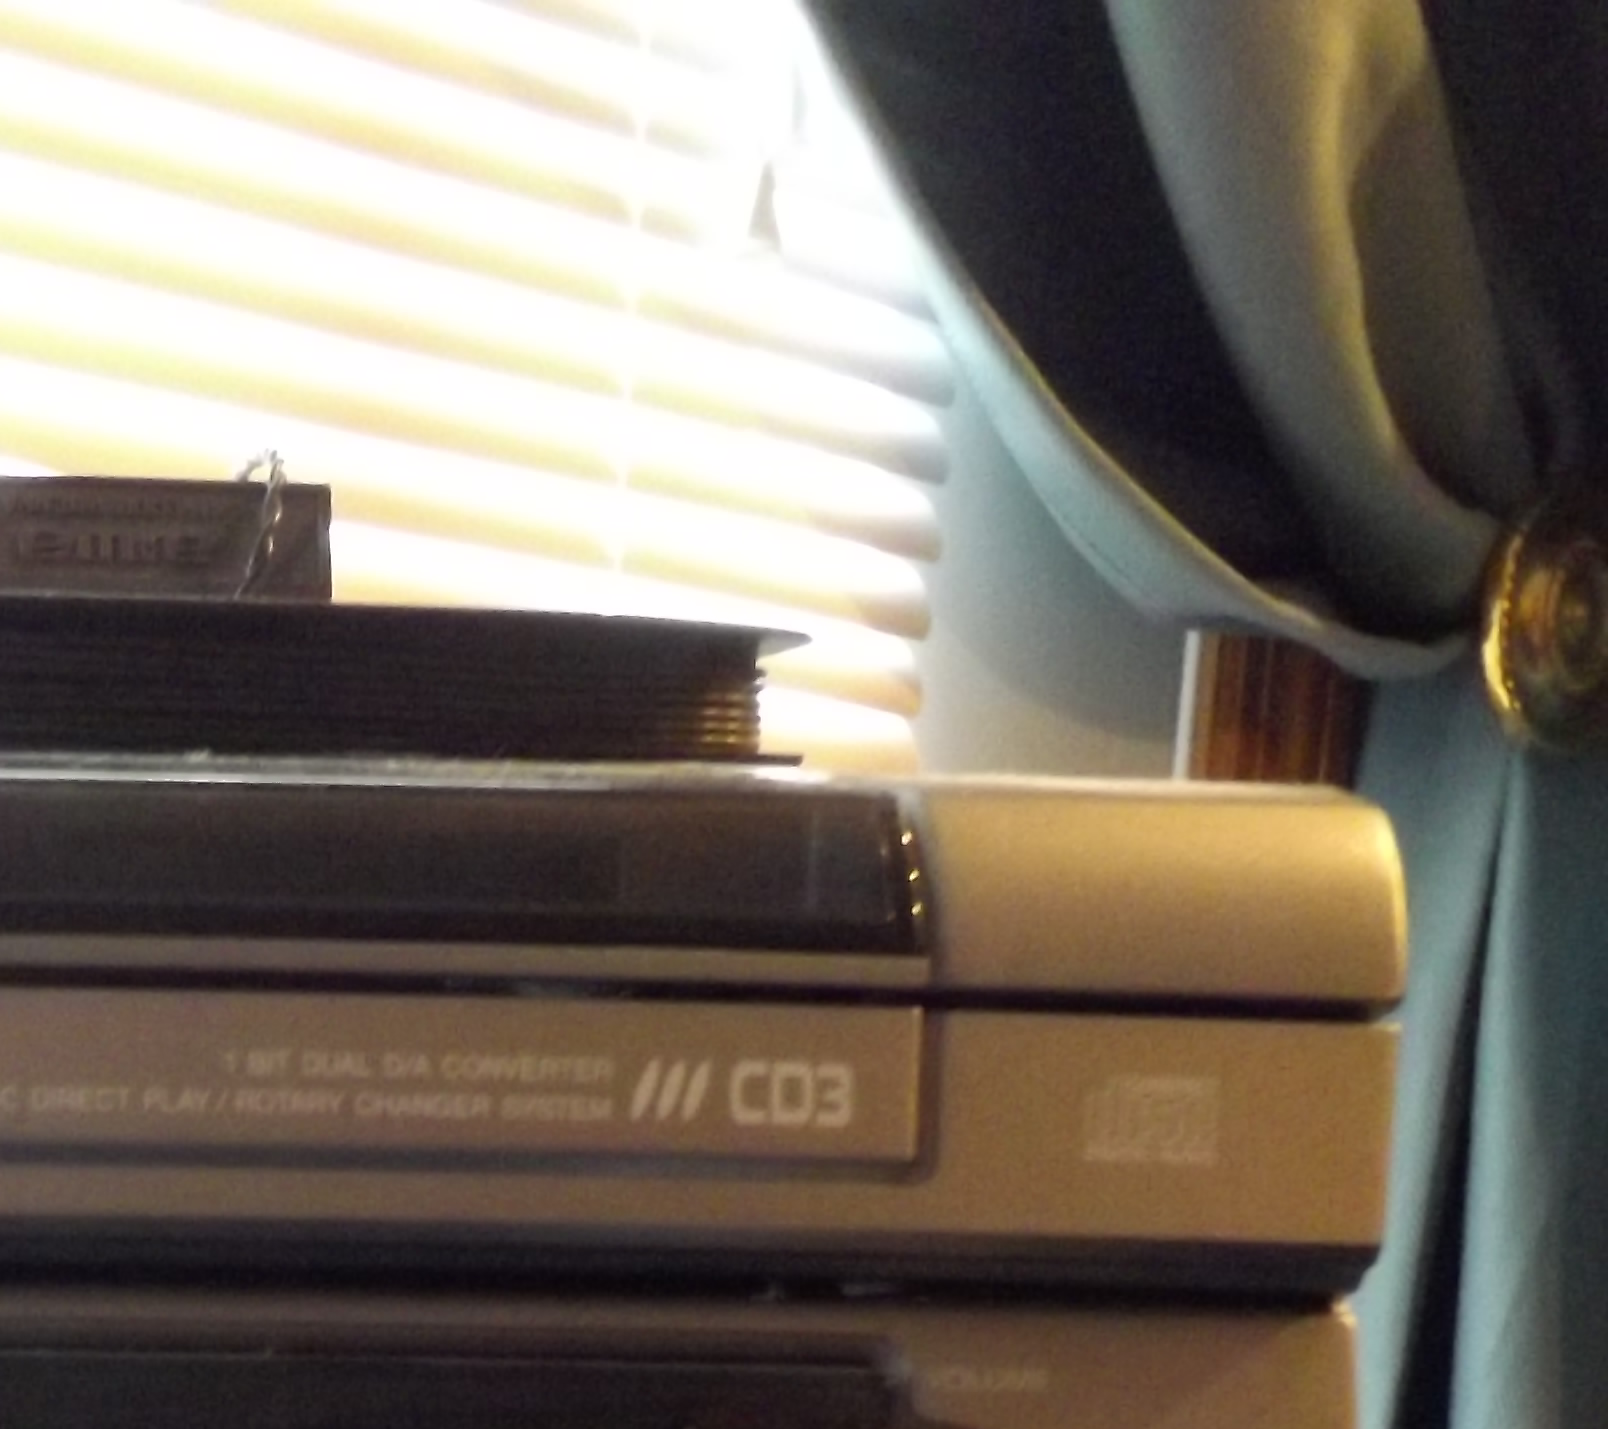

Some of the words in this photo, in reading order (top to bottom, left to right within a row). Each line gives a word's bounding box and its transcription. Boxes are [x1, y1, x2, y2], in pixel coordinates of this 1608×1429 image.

[301, 1051, 371, 1079] DUAL
[381, 1052, 432, 1079] D/A
[440, 1053, 616, 1083] CONVERTER
[30, 1084, 130, 1114] DIRECT
[352, 1091, 492, 1120] CHANGER
[499, 1093, 613, 1122] SYSTEM
[729, 1058, 855, 1129] CD3
